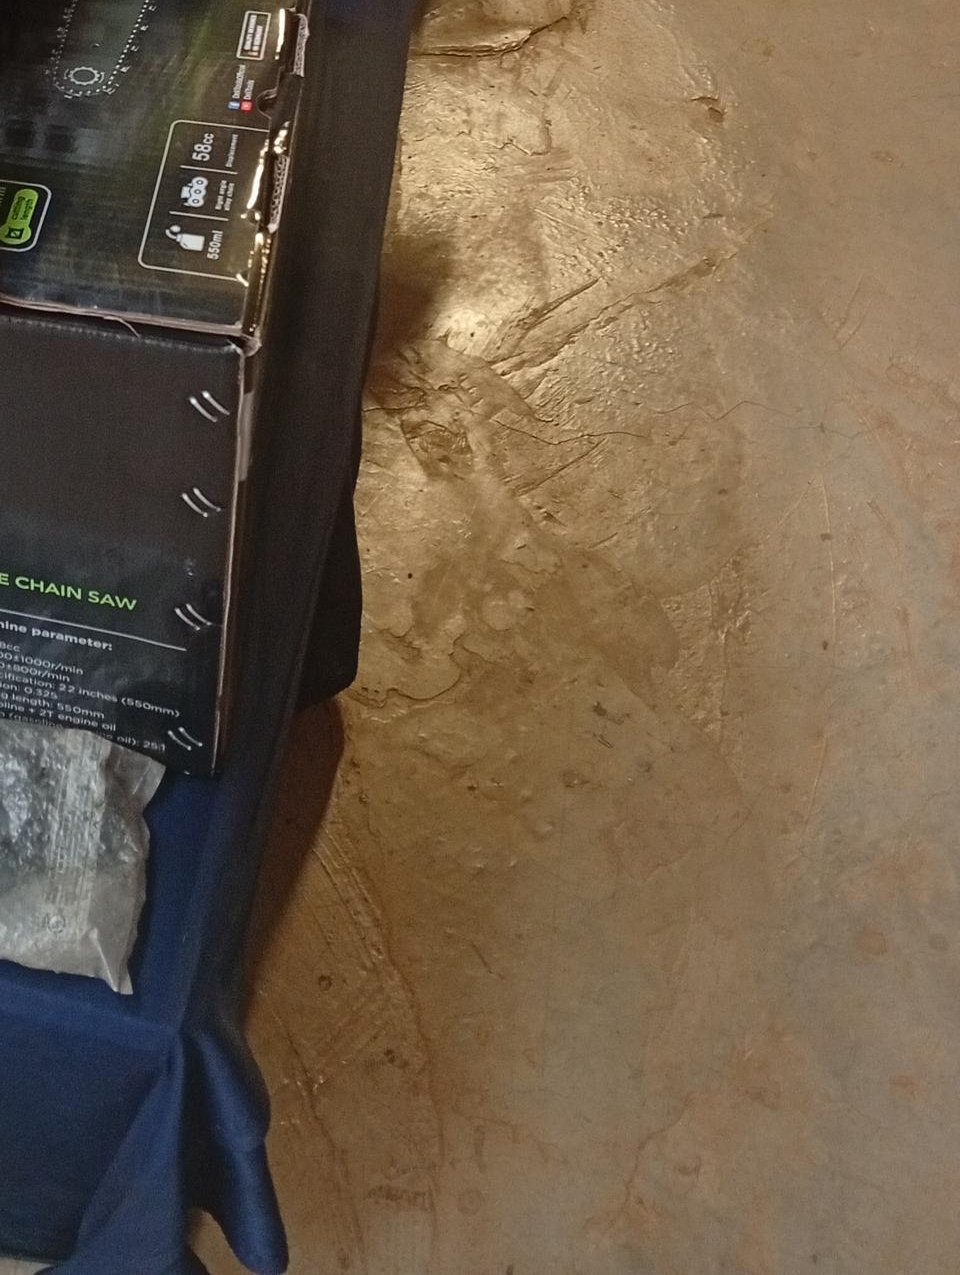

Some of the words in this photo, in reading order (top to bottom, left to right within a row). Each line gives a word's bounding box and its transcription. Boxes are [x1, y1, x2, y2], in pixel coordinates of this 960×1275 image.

[192, 132, 215, 162] 58cc
[225, 134, 239, 168] Displacement
[207, 229, 224, 260] 550ml
[15, 576, 82, 600] CHAIN
[87, 590, 137, 611] SAW
[31, 627, 113, 652] parameter:
[12, 692, 54, 708] length:
[57, 702, 105, 720] 550mm
[58, 683, 75, 694] 22
[78, 688, 118, 703] inches
[121, 697, 180, 718] (550mm)
[40, 708, 54, 718] 2T
[57, 713, 99, 728] engine
[102, 722, 117, 732] oil
